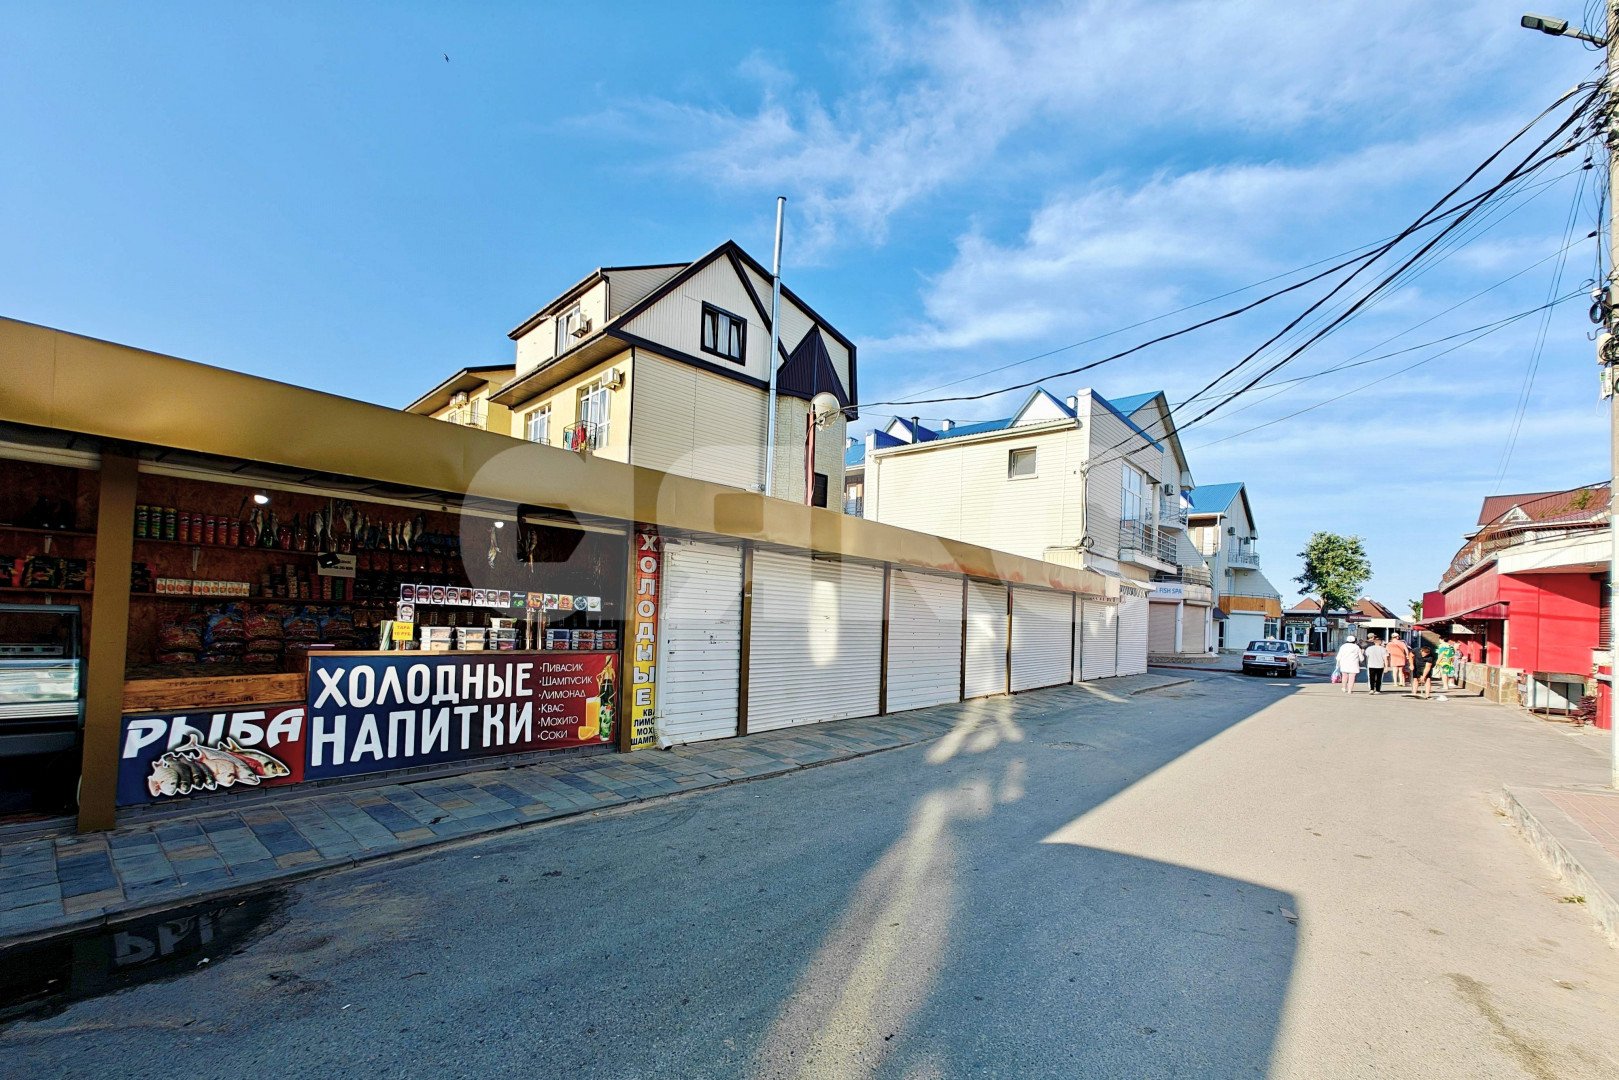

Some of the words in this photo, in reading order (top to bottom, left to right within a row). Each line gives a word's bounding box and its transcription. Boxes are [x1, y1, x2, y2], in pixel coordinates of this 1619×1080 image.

[633, 533, 658, 706] ХОЛОДНЫЕ
[313, 661, 534, 709] ХОЛОДНЫЕ
[122, 708, 306, 760] РЫБА
[310, 702, 534, 767] НАПИТКИ
